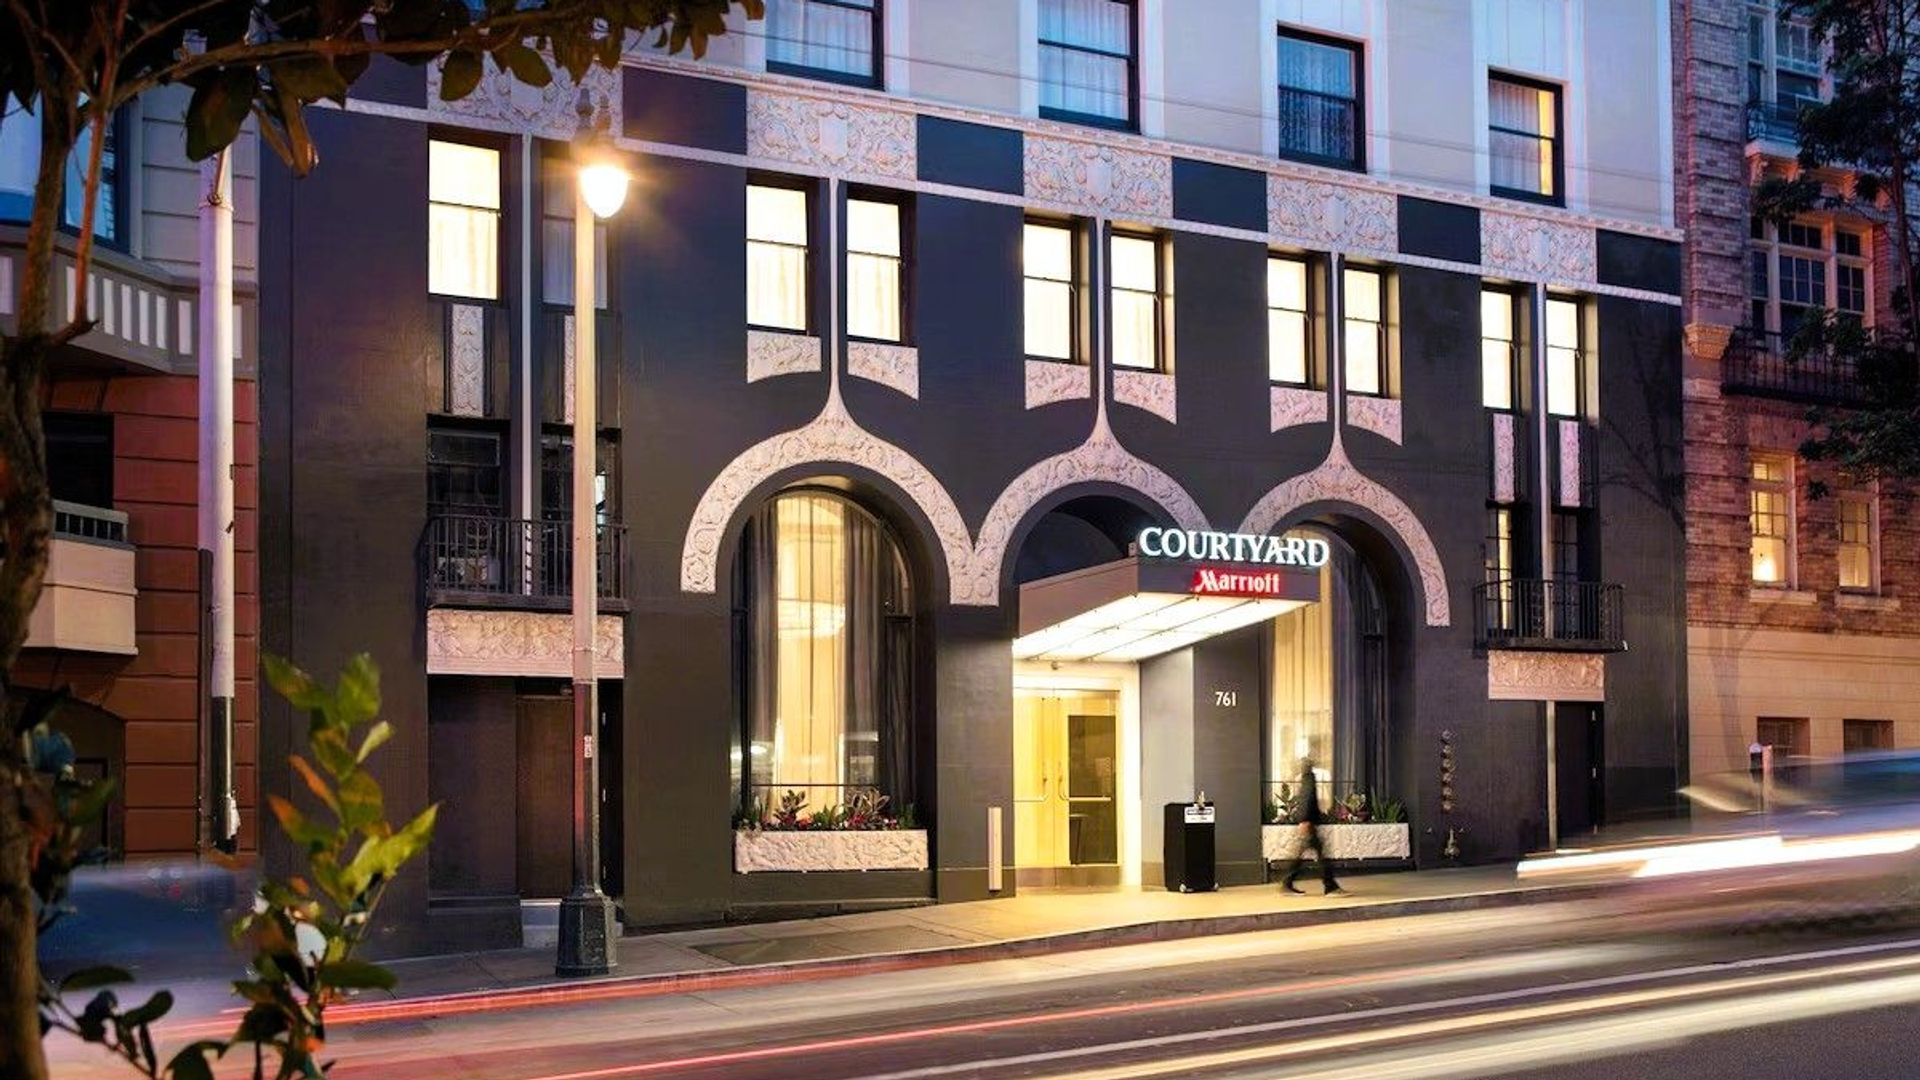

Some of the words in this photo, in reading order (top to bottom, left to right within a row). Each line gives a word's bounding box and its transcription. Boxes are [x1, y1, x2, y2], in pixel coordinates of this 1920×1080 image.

[1138, 527, 1330, 567] COURTYARD
[1193, 569, 1280, 594] Marriott
[1215, 691, 1237, 707] 761
